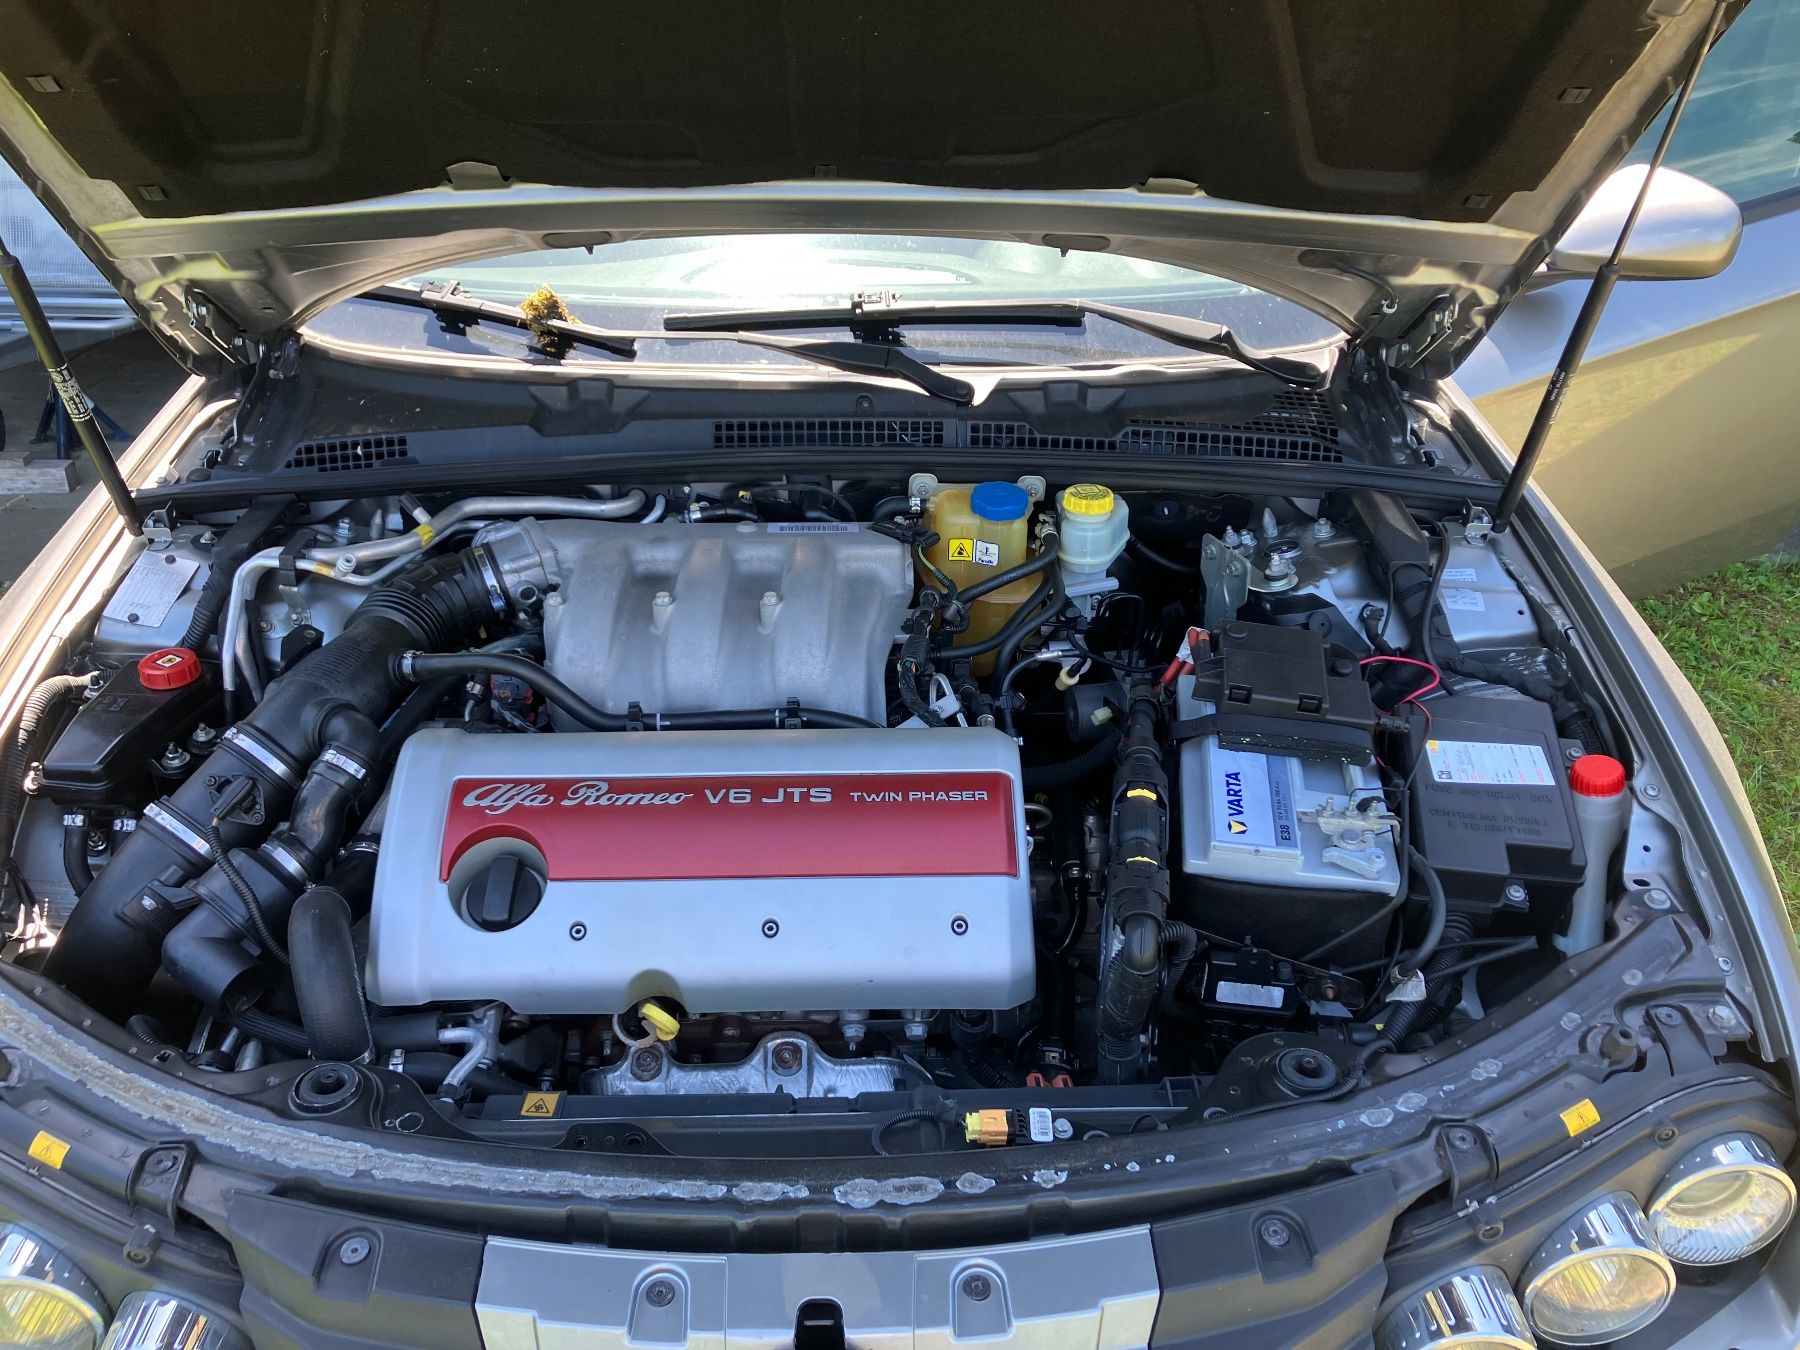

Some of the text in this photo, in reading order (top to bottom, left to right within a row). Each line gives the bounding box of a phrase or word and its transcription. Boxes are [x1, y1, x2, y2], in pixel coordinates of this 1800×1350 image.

[463, 780, 988, 815] Alfa Romeo V6 JTS TWIN PHASER
[1225, 771, 1244, 816] VARTA
[1279, 824, 1291, 841] E38
